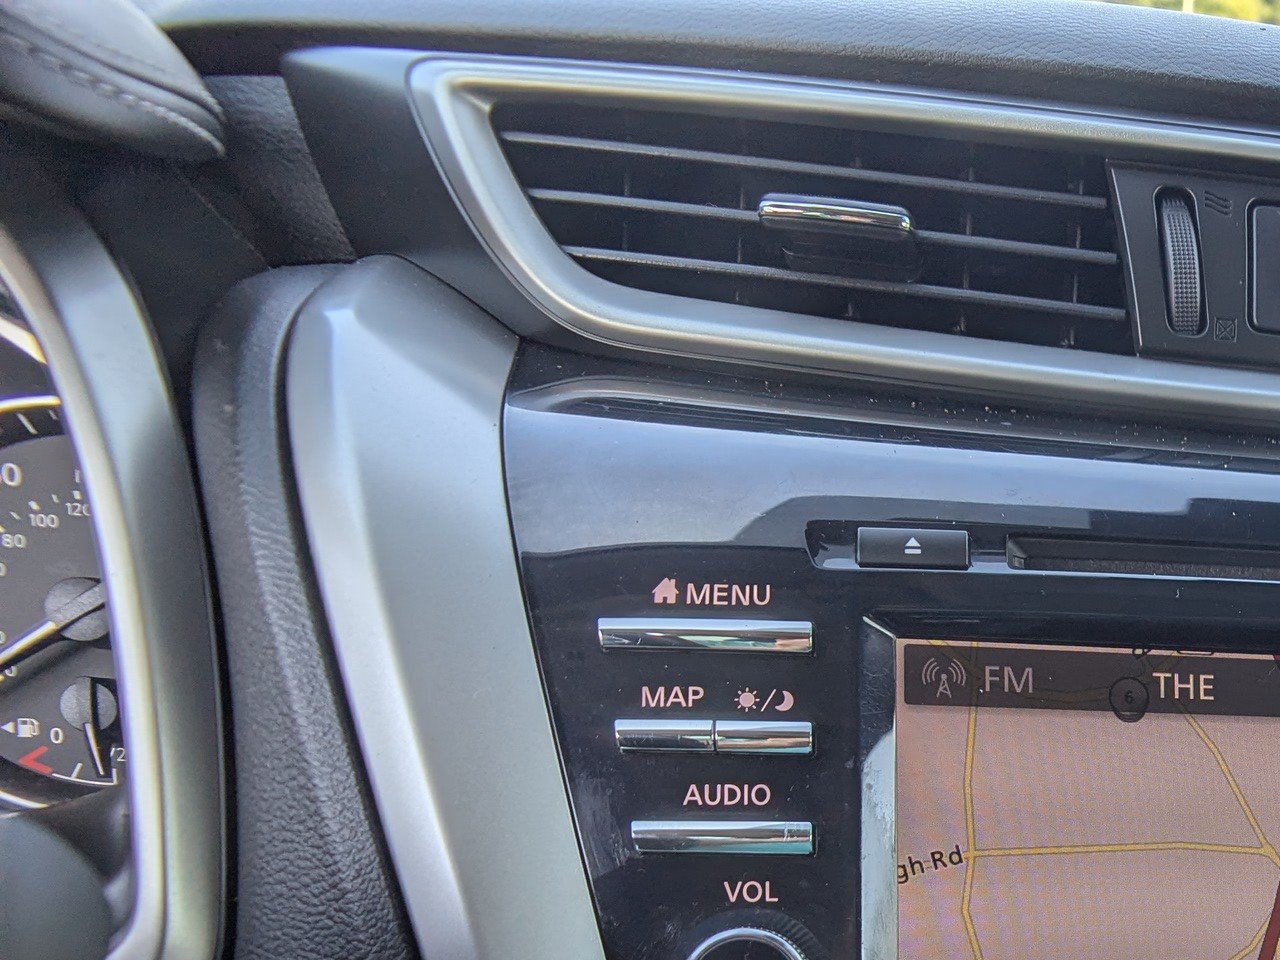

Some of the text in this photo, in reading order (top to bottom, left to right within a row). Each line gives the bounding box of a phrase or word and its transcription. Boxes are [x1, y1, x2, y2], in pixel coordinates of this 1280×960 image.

[28, 513, 60, 528] 100
[685, 582, 772, 606] MENU
[983, 665, 1034, 695] FM
[1151, 671, 1215, 701] THE
[641, 685, 705, 708] MAP
[682, 783, 772, 806] AUDIO
[929, 844, 964, 870] Rd
[723, 880, 779, 903] VOL
